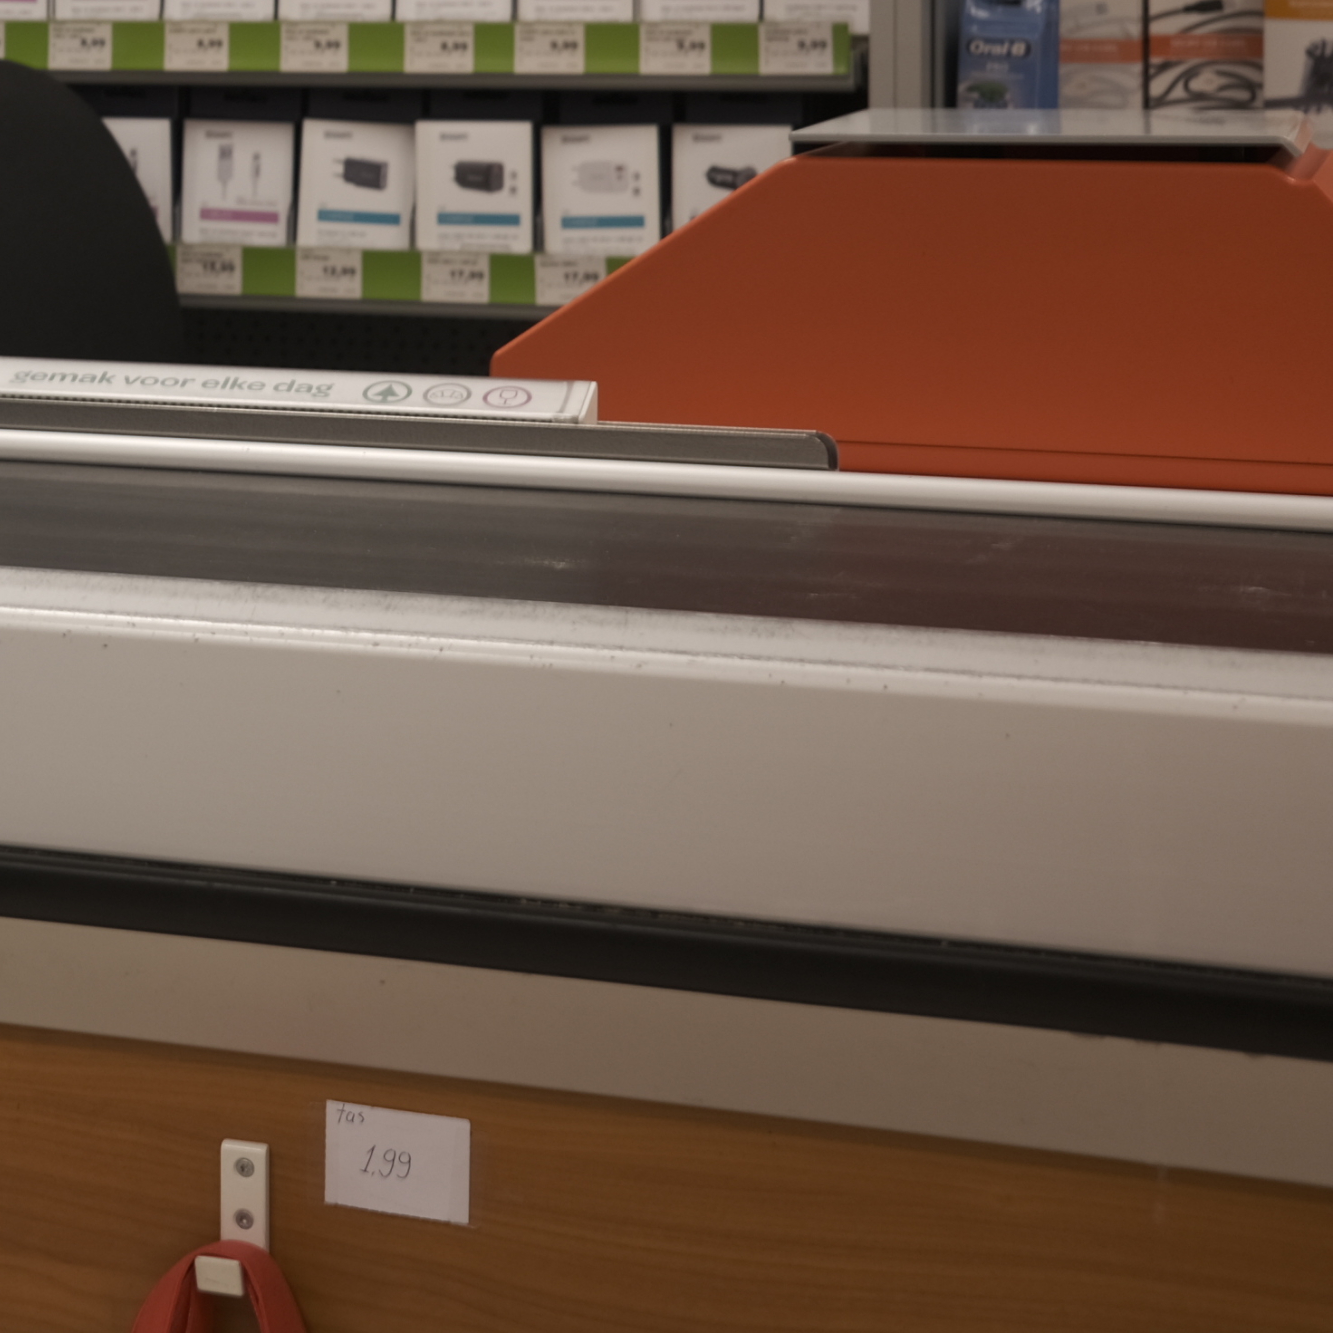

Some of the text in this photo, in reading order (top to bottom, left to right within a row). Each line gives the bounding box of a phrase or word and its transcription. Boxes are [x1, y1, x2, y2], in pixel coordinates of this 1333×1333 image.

[9, 367, 336, 399] gemak voor elke dag
[335, 1103, 366, 1124] tas
